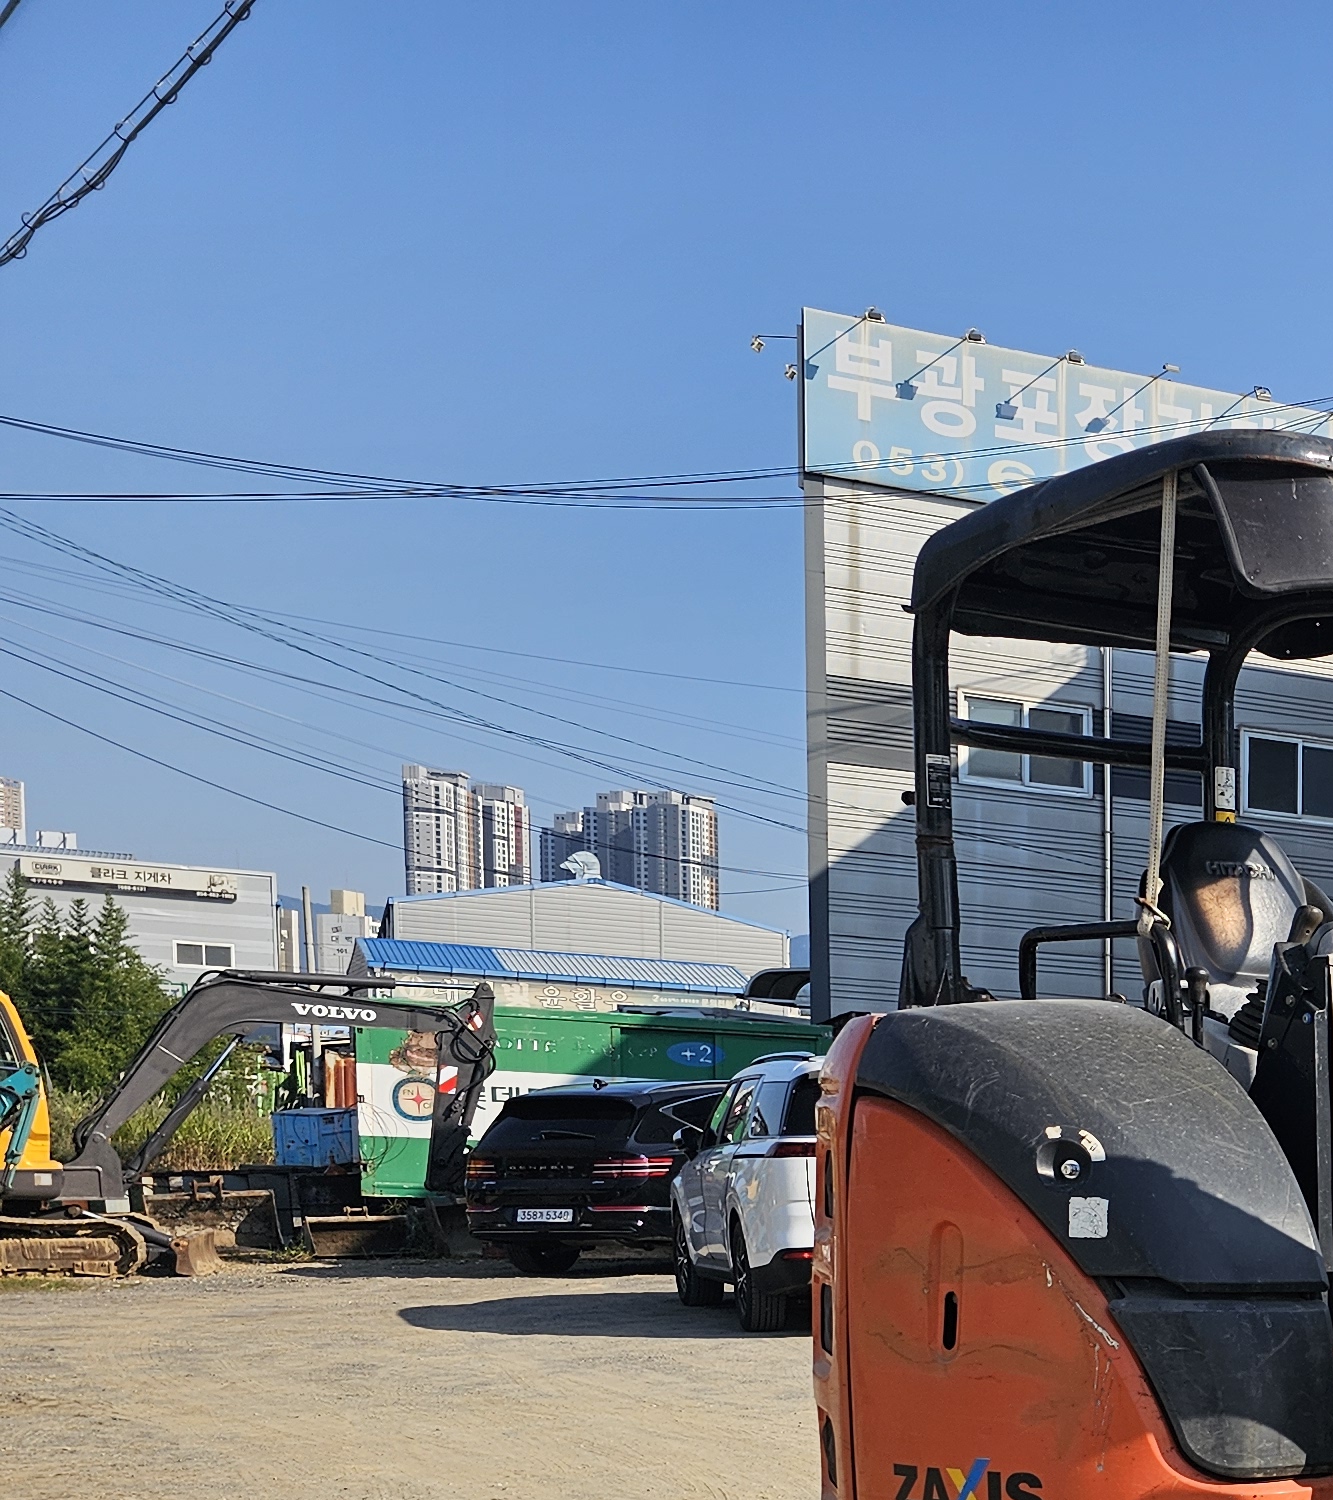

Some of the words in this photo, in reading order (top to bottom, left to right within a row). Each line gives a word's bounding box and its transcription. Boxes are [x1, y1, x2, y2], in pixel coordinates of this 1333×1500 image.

[90, 866, 129, 881] 클라크
[134, 871, 172, 885] 지게차
[291, 1003, 377, 1022] VOLVO
[680, 1046, 712, 1064] +2
